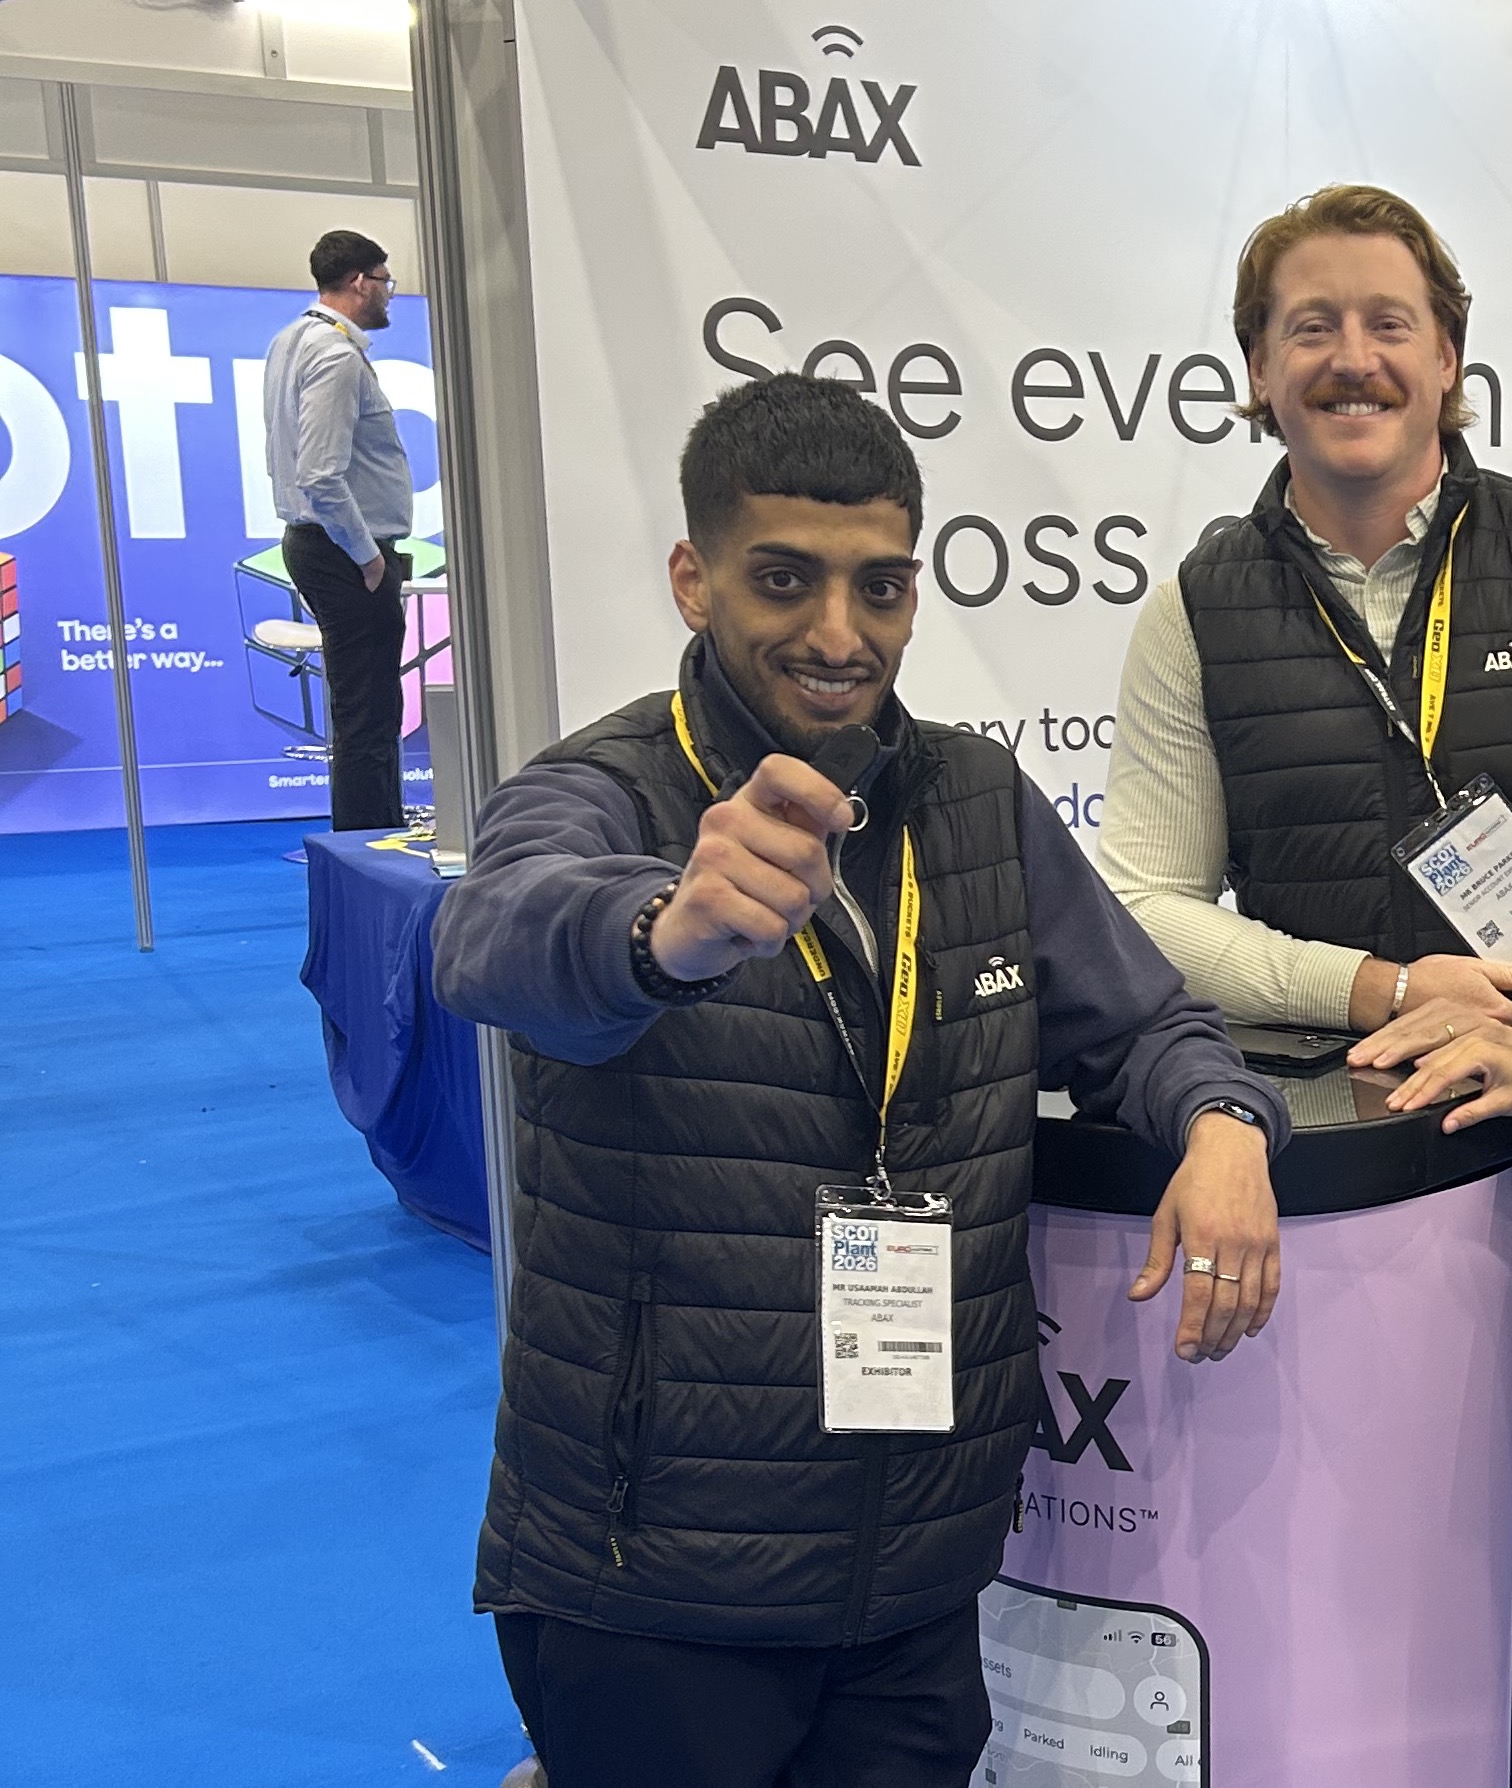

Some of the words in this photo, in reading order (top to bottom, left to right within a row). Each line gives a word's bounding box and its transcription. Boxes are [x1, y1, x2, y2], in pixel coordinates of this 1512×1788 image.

[695, 65, 922, 167] ABAX
[160, 623, 179, 640] a
[61, 649, 147, 671] bettr
[150, 651, 224, 673] way...
[1421, 843, 1457, 877] SCOT
[1437, 865, 1471, 895] 2026
[1471, 869, 1494, 891] BRUCE
[974, 964, 1024, 997] ABAX
[832, 1225, 878, 1240] SCOT
[833, 1240, 876, 1256] Plant
[833, 1255, 877, 1271] 2026
[832, 1283, 845, 1291] MR
[891, 1285, 933, 1294] ABDULLAH
[843, 1298, 880, 1307] TRACKING
[881, 1299, 922, 1308] SPECIALIST
[871, 1313, 894, 1322] ABAX
[861, 1366, 912, 1376] EXHIBITOR
[1154, 1634, 1172, 1645] 56
[1023, 1727, 1065, 1749] Parked
[1089, 1744, 1129, 1763] Idling
[1174, 1754, 1194, 1767] All
